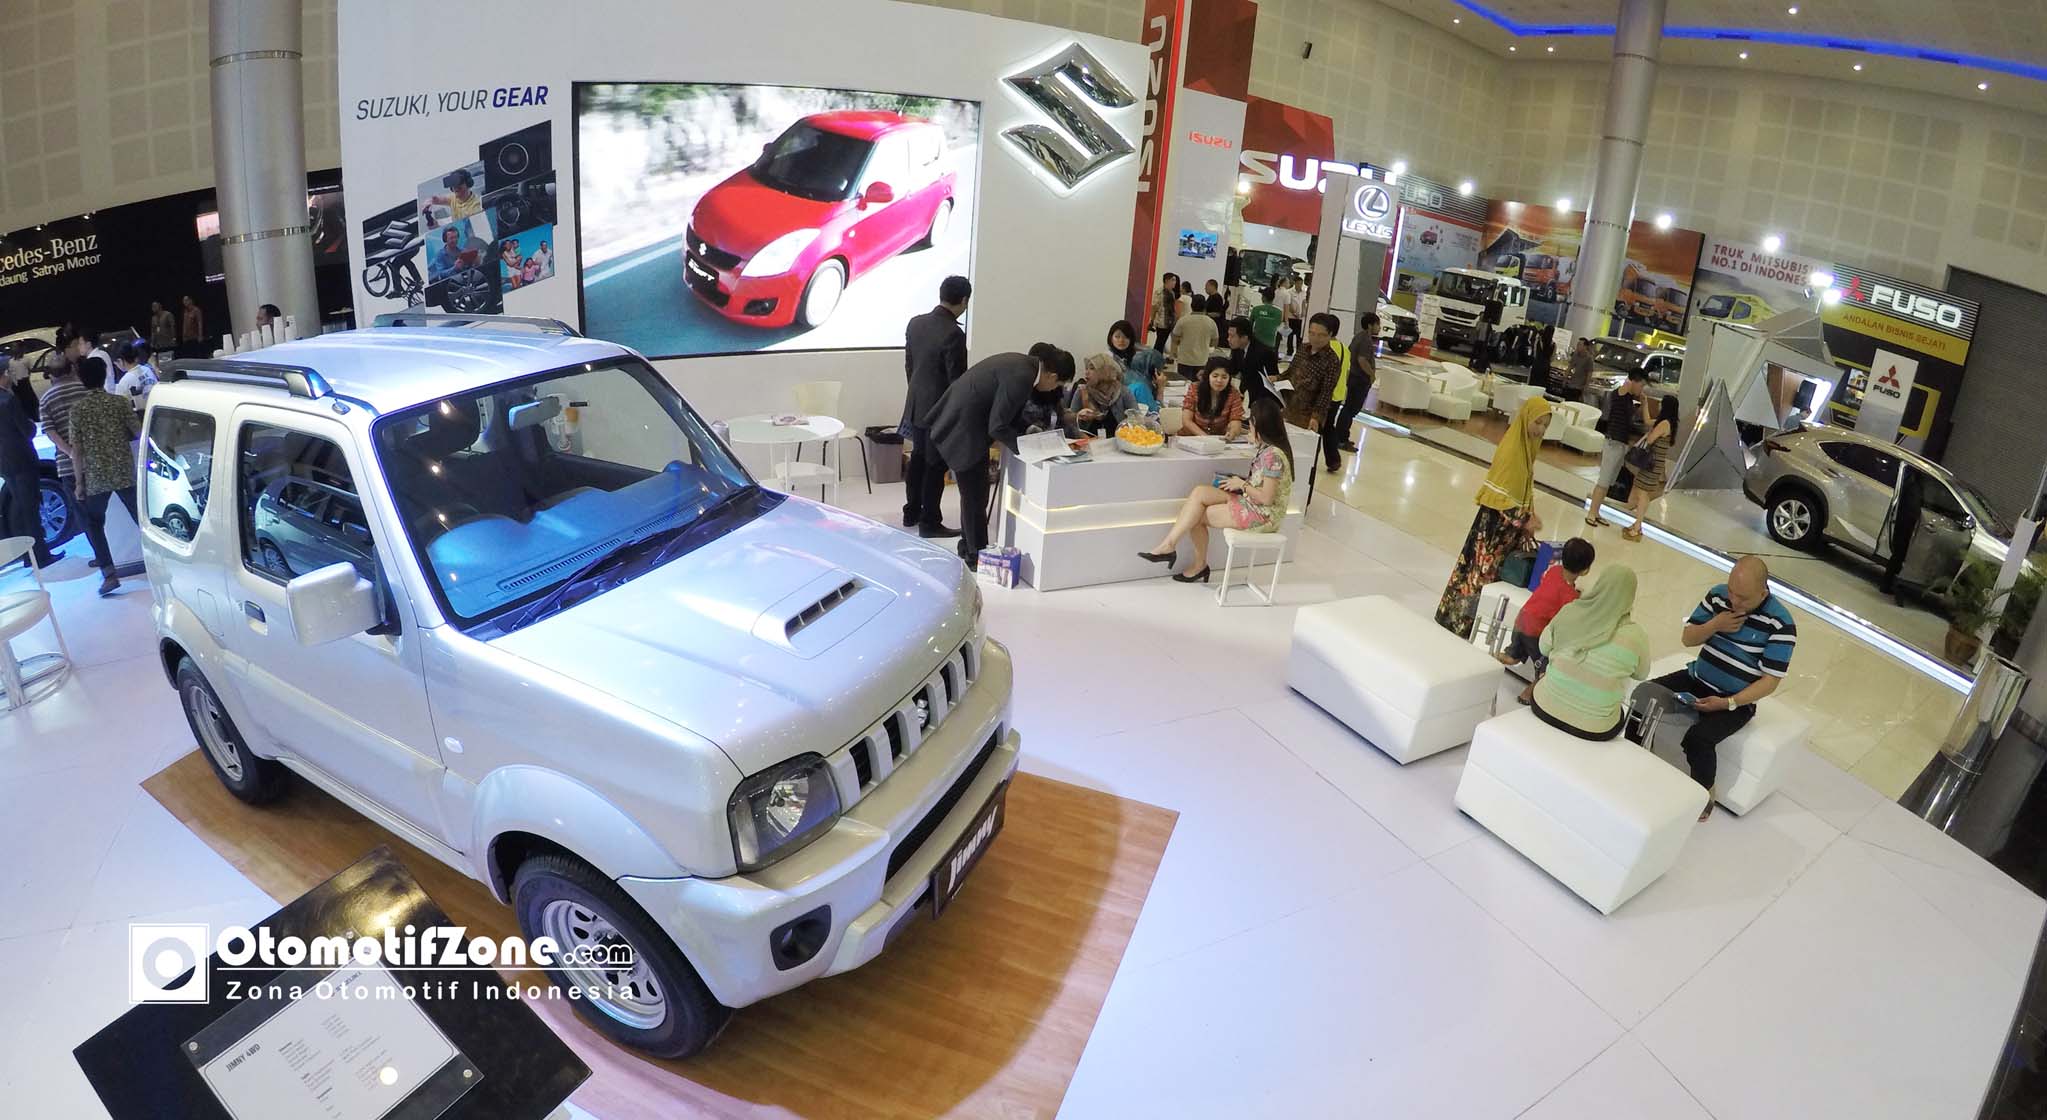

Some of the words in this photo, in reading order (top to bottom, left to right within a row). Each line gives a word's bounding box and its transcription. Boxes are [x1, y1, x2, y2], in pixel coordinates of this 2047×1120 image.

[356, 94, 430, 120] SUZUKI,
[438, 89, 488, 112] YOUR
[492, 86, 549, 108] GEAR
[1188, 131, 1232, 149] ISUZU
[1342, 218, 1393, 239] LEXUS
[32, 262, 65, 278] Satrya
[67, 254, 101, 269] Motor
[1711, 255, 1737, 270] NO.1
[1740, 261, 1752, 273] DI
[1755, 265, 1813, 287] INDONES
[1713, 244, 1744, 259] TRUK
[1751, 252, 1820, 276] MITSUBIS
[1870, 284, 1962, 329] FUSO
[1843, 314, 1884, 334] ANDALAN
[1916, 334, 1946, 351] SEJATI
[1872, 384, 1901, 399] FUSO
[946, 805, 998, 894] Jimny
[226, 1054, 246, 1071] JIMNY
